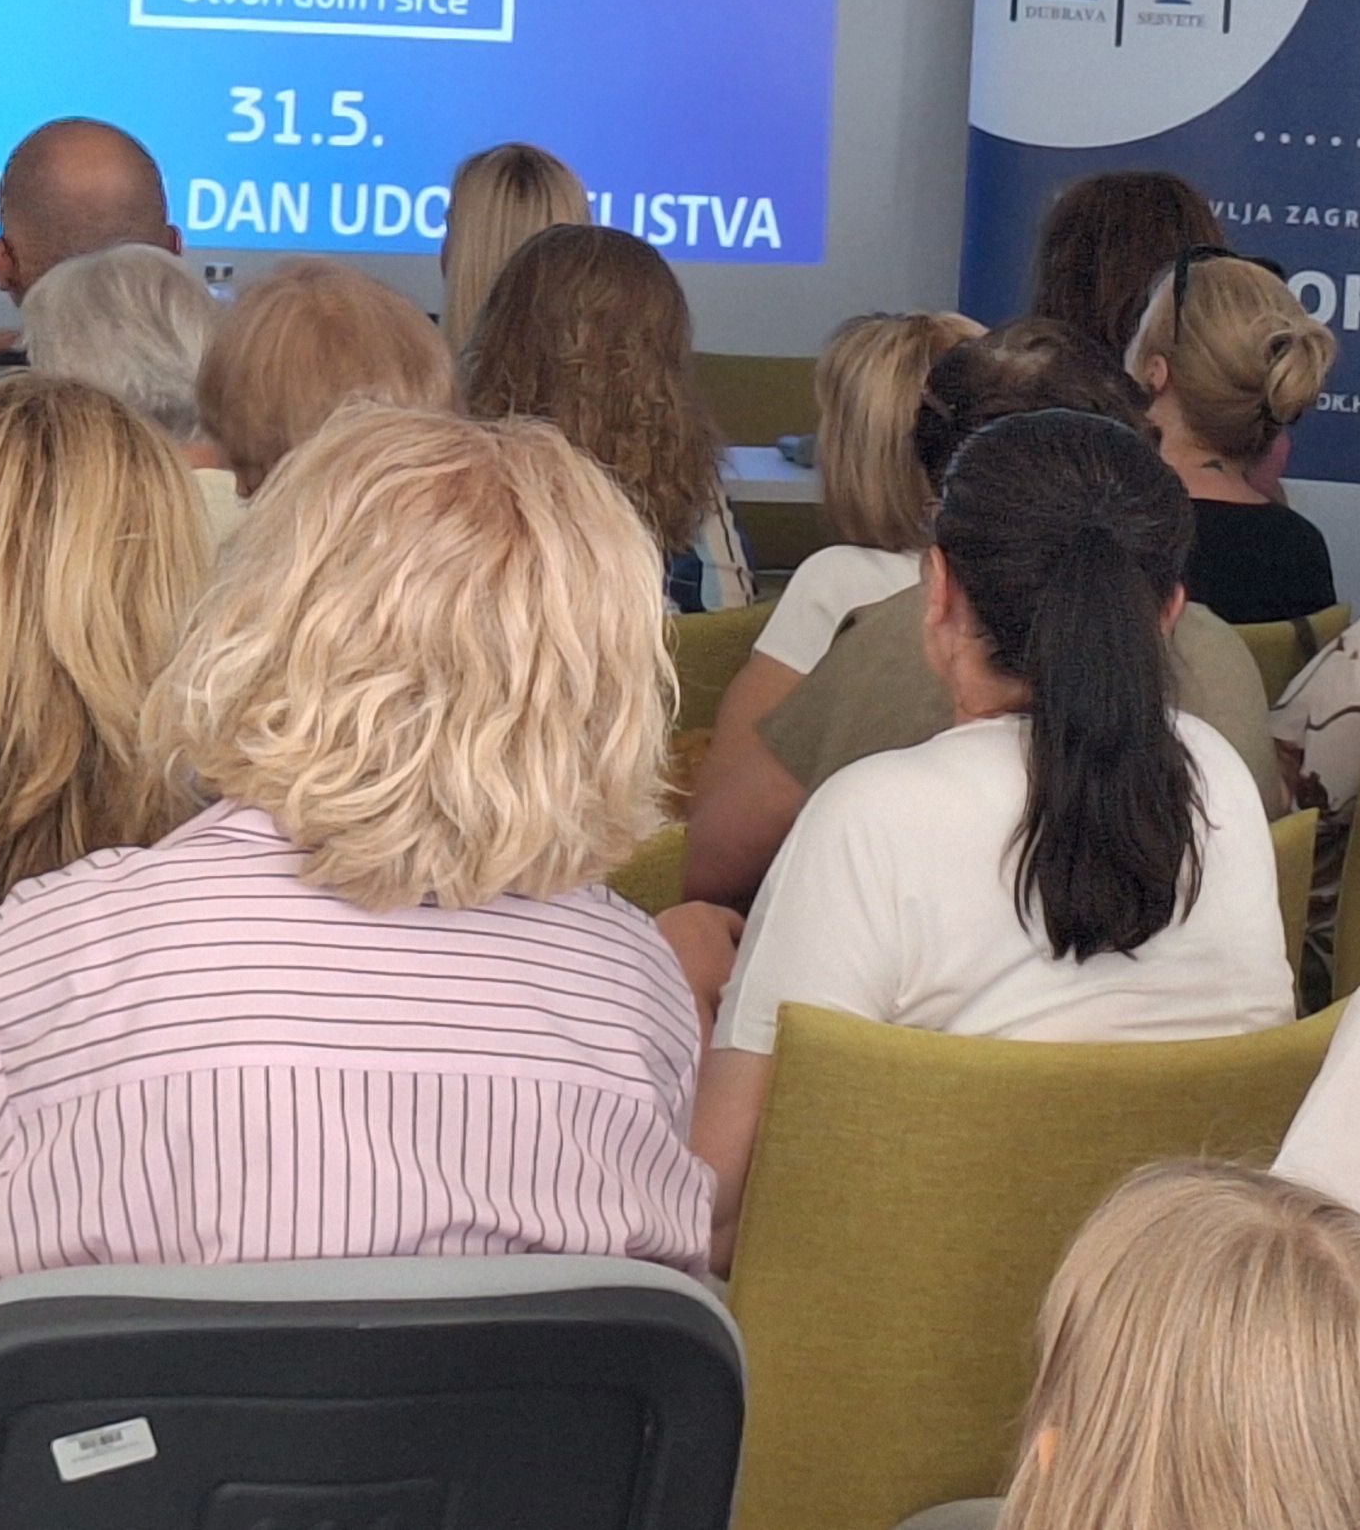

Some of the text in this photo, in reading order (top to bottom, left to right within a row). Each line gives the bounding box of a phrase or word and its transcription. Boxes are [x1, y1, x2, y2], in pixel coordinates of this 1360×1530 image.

[1025, 6, 1106, 22] DUBRAVA
[226, 86, 384, 147] 31.5.
[187, 178, 310, 235] DAN
[1208, 200, 1273, 225] VLJA
